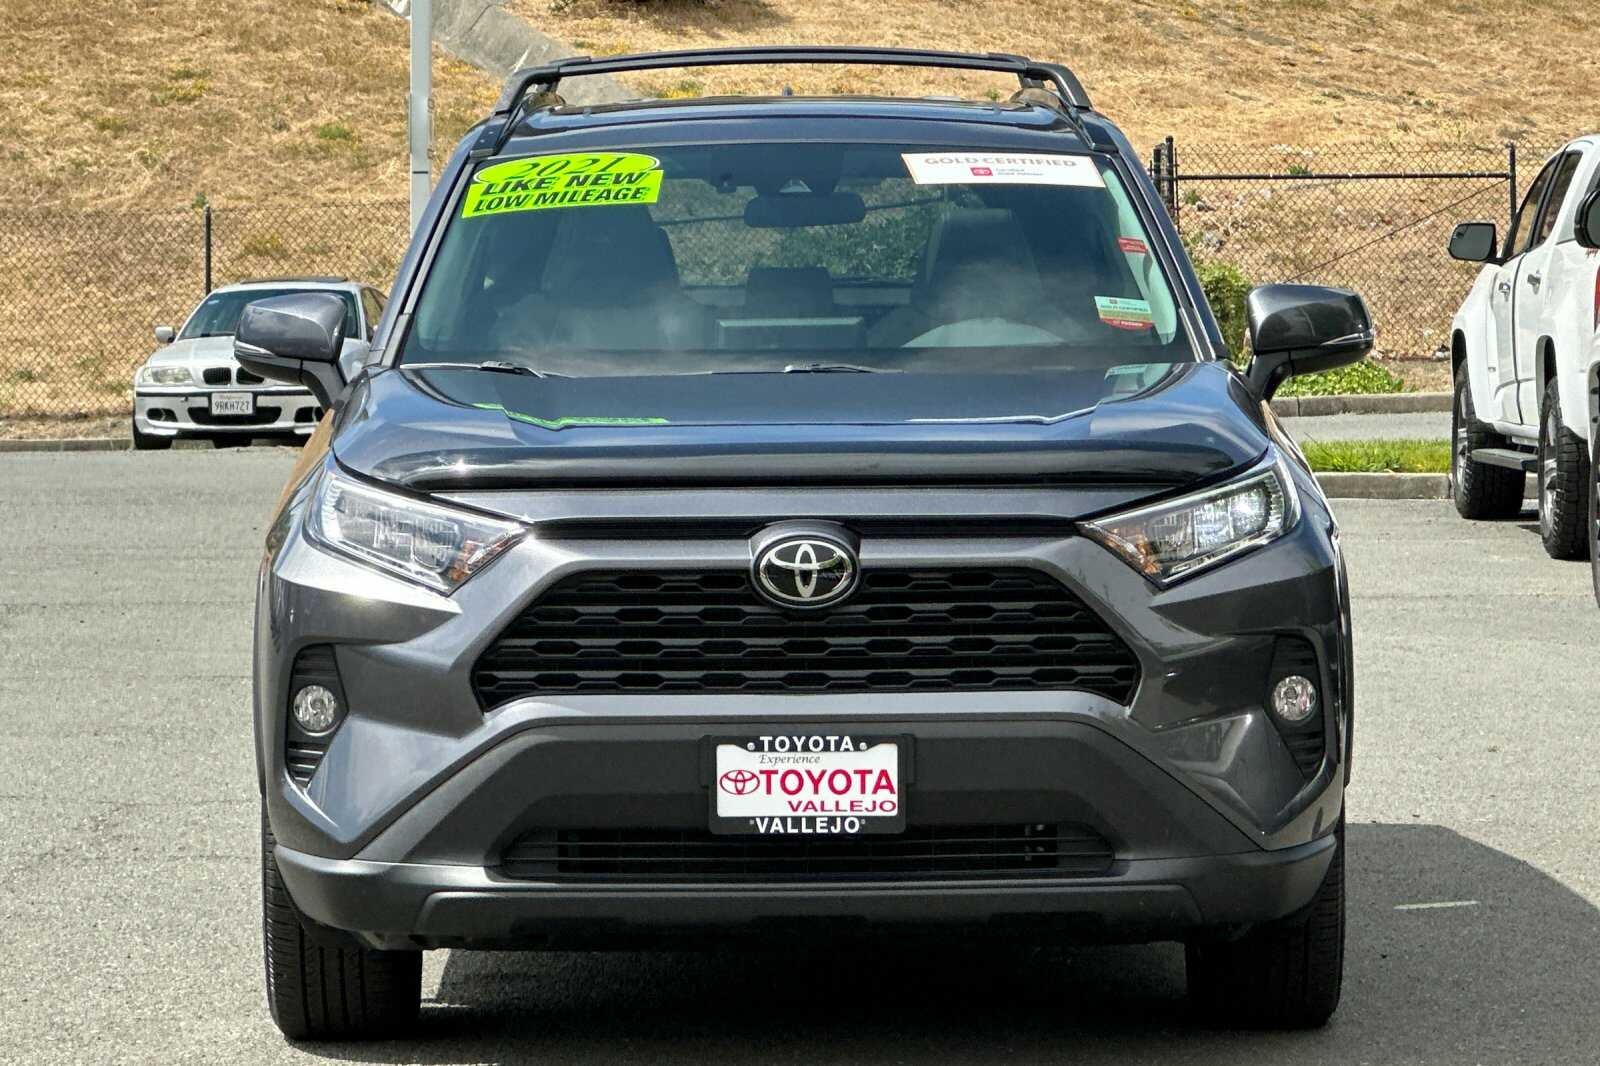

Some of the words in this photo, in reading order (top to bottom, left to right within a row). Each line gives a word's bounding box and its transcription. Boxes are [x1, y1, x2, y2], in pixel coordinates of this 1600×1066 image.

[505, 156, 626, 180] 2021
[924, 157, 979, 165] GOLD
[982, 157, 1078, 167] CERTIFIED
[480, 176, 560, 196] LIKE
[564, 171, 649, 188] NEW
[472, 194, 530, 213] LOW
[533, 187, 649, 206] MILEAGE
[759, 735, 855, 752] TOYOTA
[758, 754, 821, 766] Experience
[759, 769, 896, 795] TOYOTA
[787, 800, 897, 812] VALLEJO
[755, 817, 861, 834] VALLEJO
